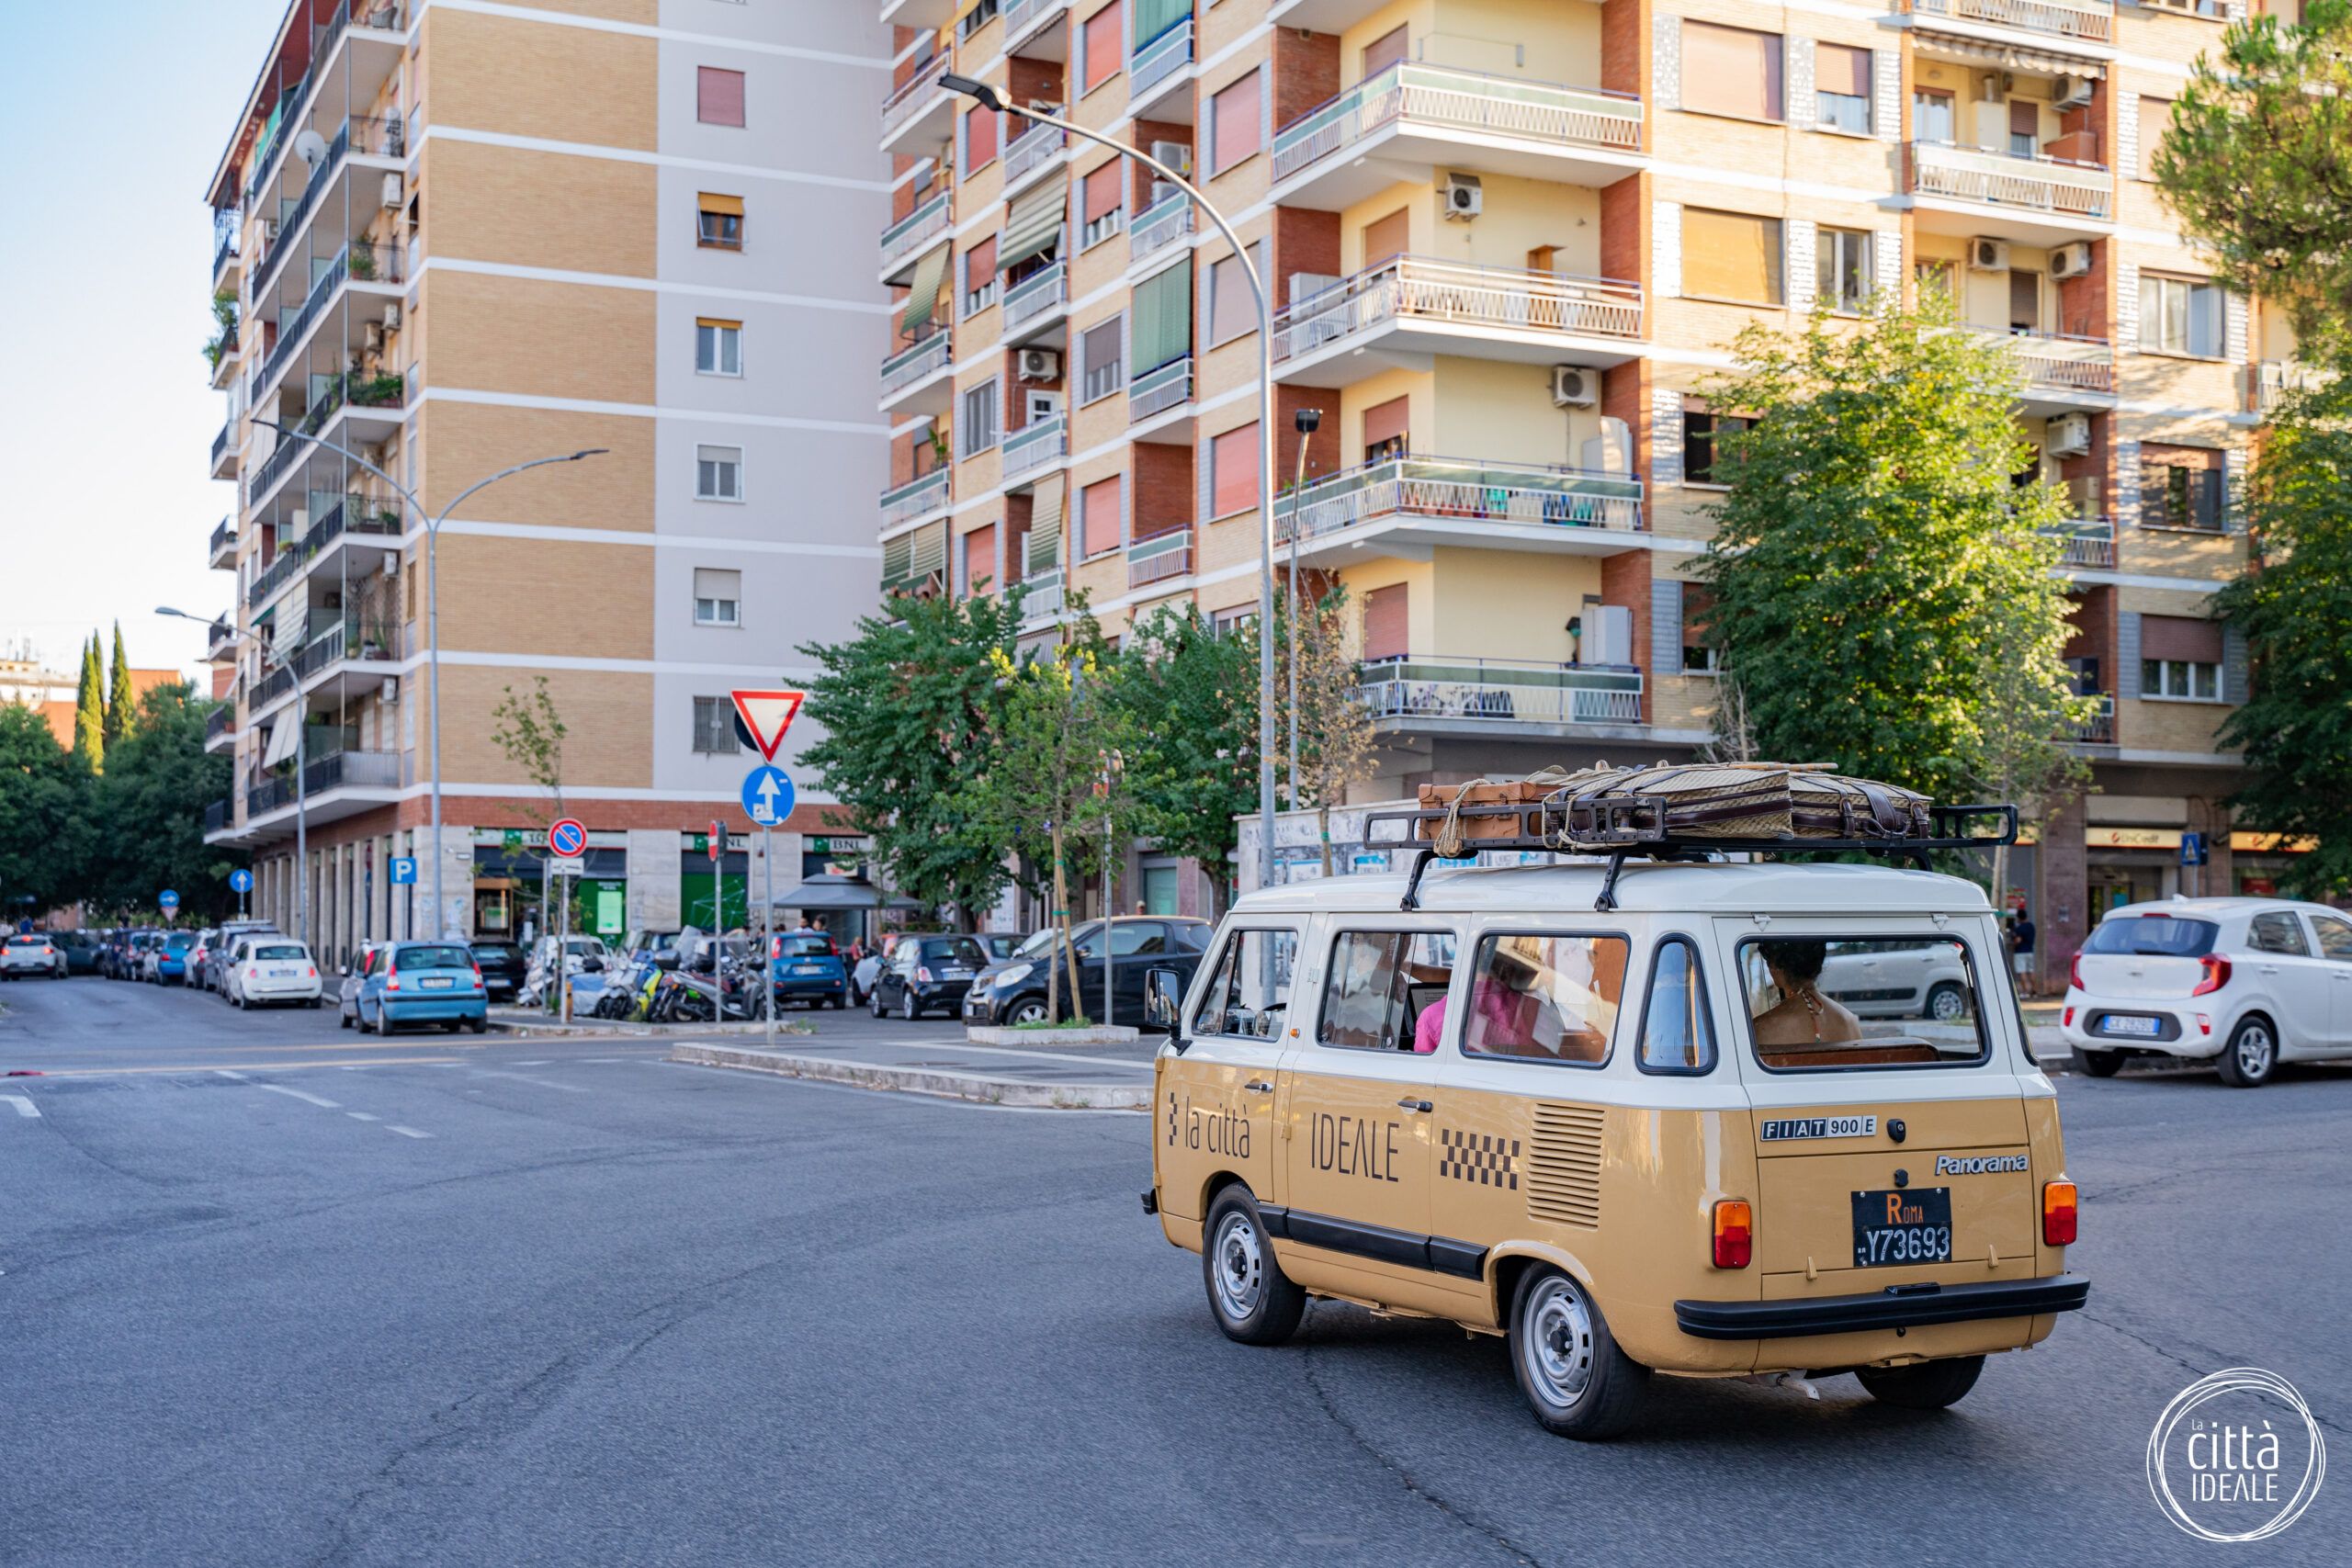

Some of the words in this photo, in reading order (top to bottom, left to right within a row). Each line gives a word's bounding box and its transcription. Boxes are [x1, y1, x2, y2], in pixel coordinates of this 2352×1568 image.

[832, 840, 862, 850] BNL
[396, 861, 413, 882] P
[1185, 1096, 1200, 1150] la
[1207, 1103, 1250, 1159] città
[1765, 1120, 1825, 1139] FIAT
[1830, 1119, 1858, 1134] 900
[1865, 1118, 1874, 1133] E
[1311, 1111, 1399, 1182] IDEALE
[1935, 1154, 2029, 1176] Panorama
[1866, 1226, 1950, 1262] Y73693
